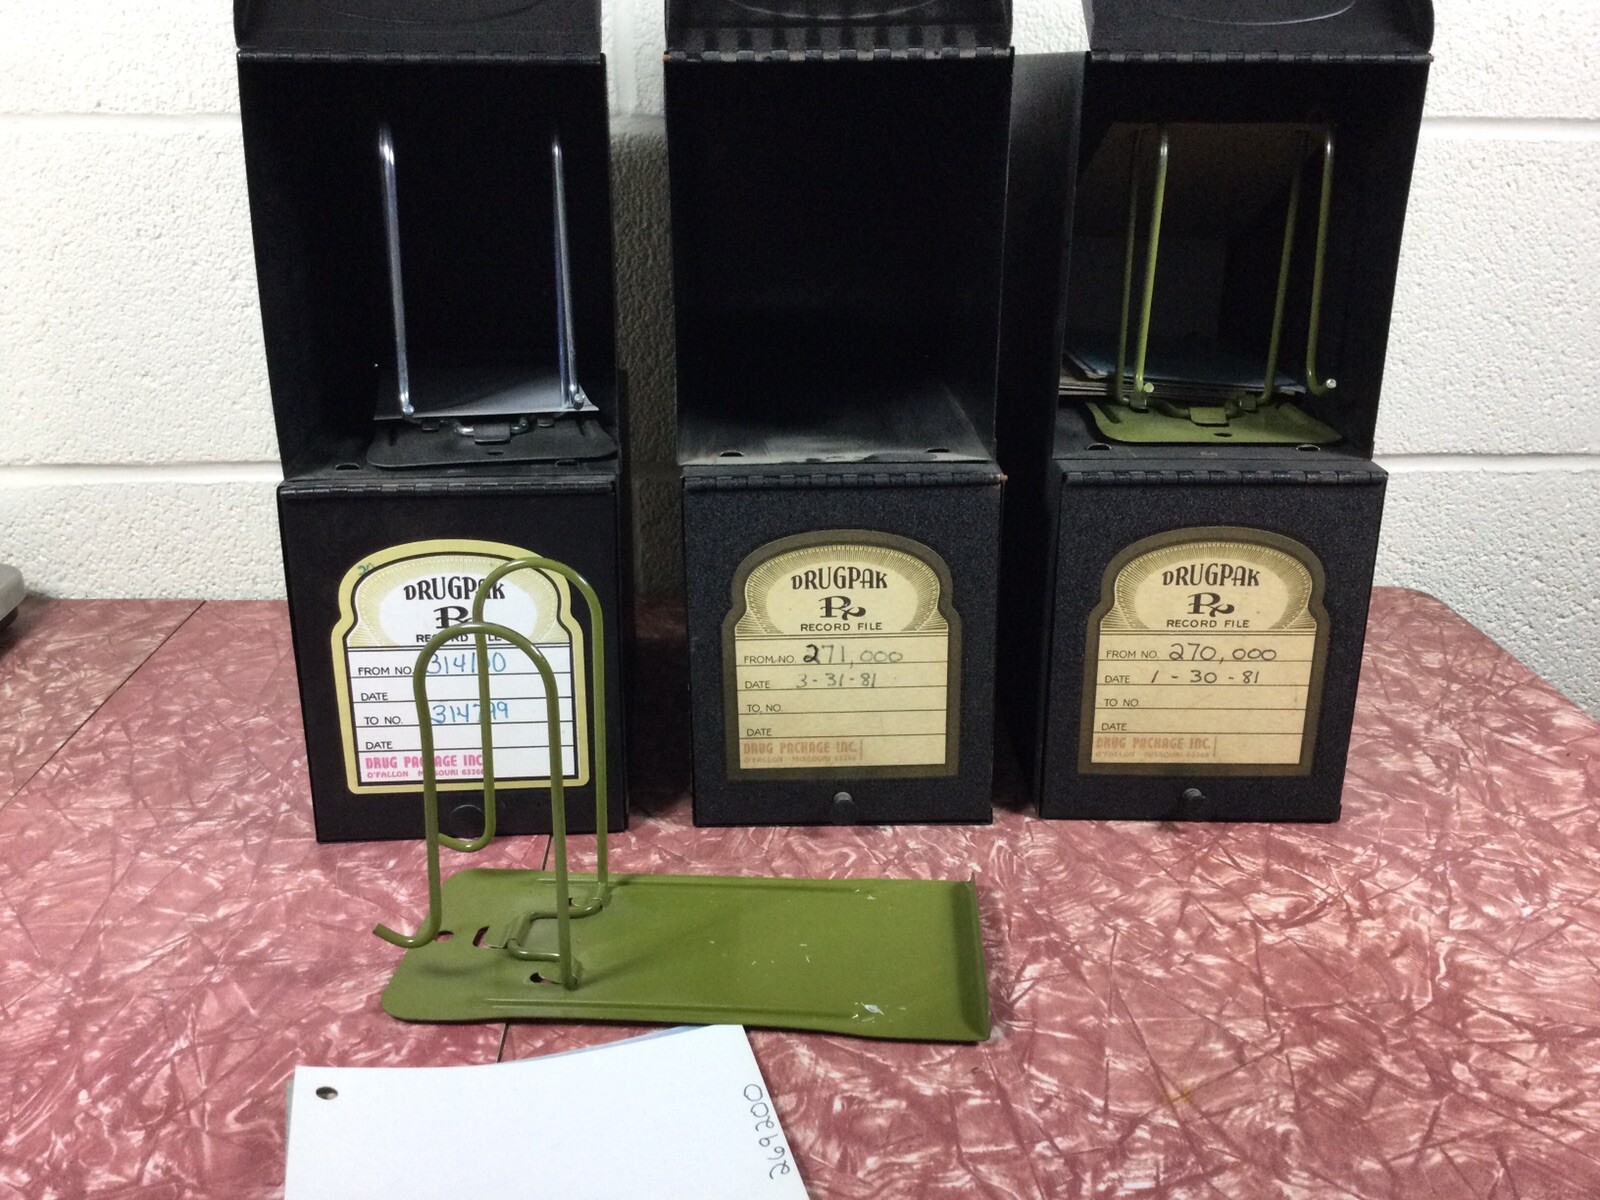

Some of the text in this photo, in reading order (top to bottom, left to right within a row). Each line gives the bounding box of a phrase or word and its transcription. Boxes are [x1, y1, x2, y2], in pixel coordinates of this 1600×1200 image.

[791, 565, 888, 590] DRUGPAK
[1162, 562, 1260, 587] DRUGPAK
[800, 622, 883, 632] RECORD FILE
[1166, 619, 1250, 629] RECORD FILE
[416, 633, 469, 643] RERD
[802, 643, 904, 670] 271,000
[1106, 649, 1160, 659] FROM NO.
[1169, 642, 1278, 665] 270,000
[426, 651, 507, 675] 31410
[743, 654, 797, 664] FROM NO.
[357, 666, 391, 676] FROM
[1104, 674, 1131, 684] DATE
[744, 680, 771, 689] DATE
[360, 692, 389, 702] DATE
[1104, 698, 1118, 707] TO
[364, 715, 404, 725] TO NO.
[1101, 722, 1127, 731] DATE
[747, 728, 772, 737] DATE
[365, 740, 394, 750] DATE
[743, 742, 774, 754] DRUG
[779, 741, 830, 754] PACKAGE
[1096, 736, 1127, 749] DRUG
[1133, 736, 1184, 749] PACKAGE
[365, 755, 398, 769] DRUG
[403, 754, 458, 768] PAAGE
[366, 770, 410, 779] O'FALLON
[743, 1083, 791, 1180] 269200
